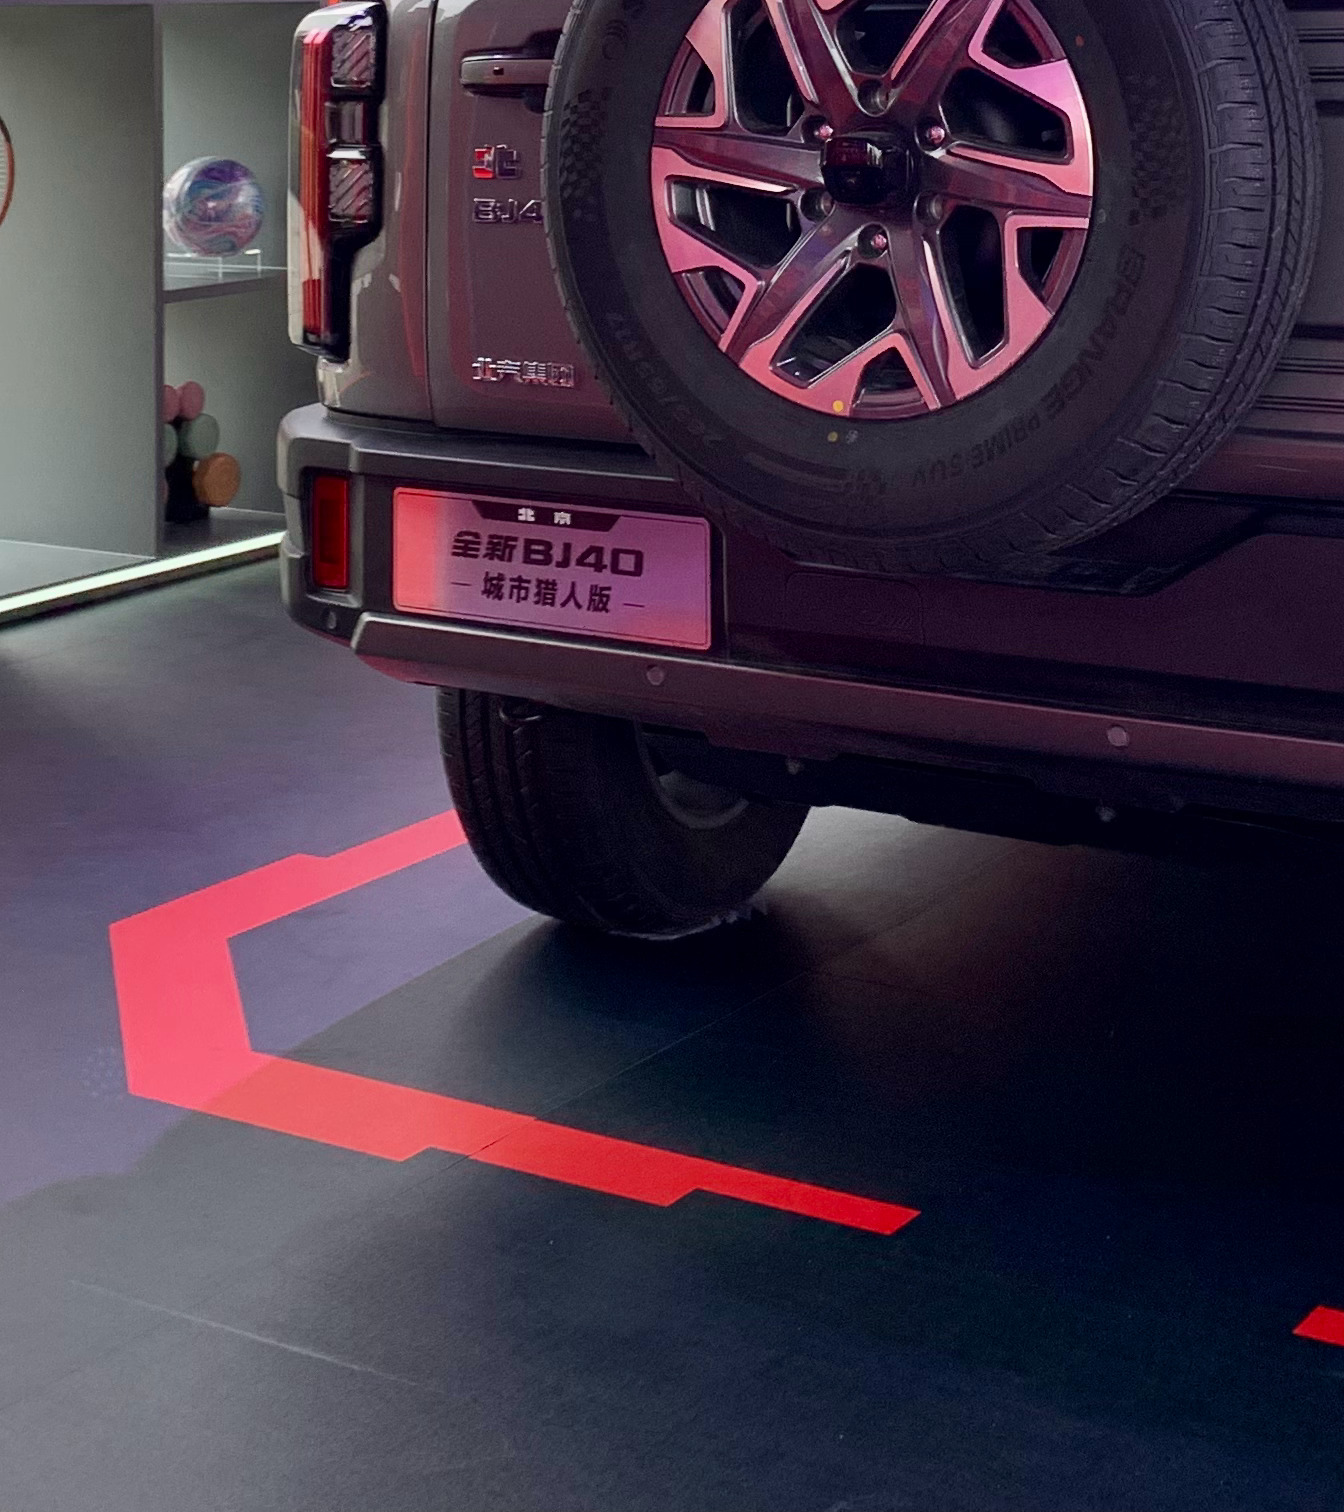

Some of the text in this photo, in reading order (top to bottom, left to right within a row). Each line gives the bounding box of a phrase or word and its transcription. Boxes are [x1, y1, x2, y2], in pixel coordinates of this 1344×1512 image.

[474, 198, 544, 223] BJ4
[518, 507, 571, 525] 北京
[451, 530, 644, 577] 全新BJ40
[481, 571, 612, 613] 城市猎人版
